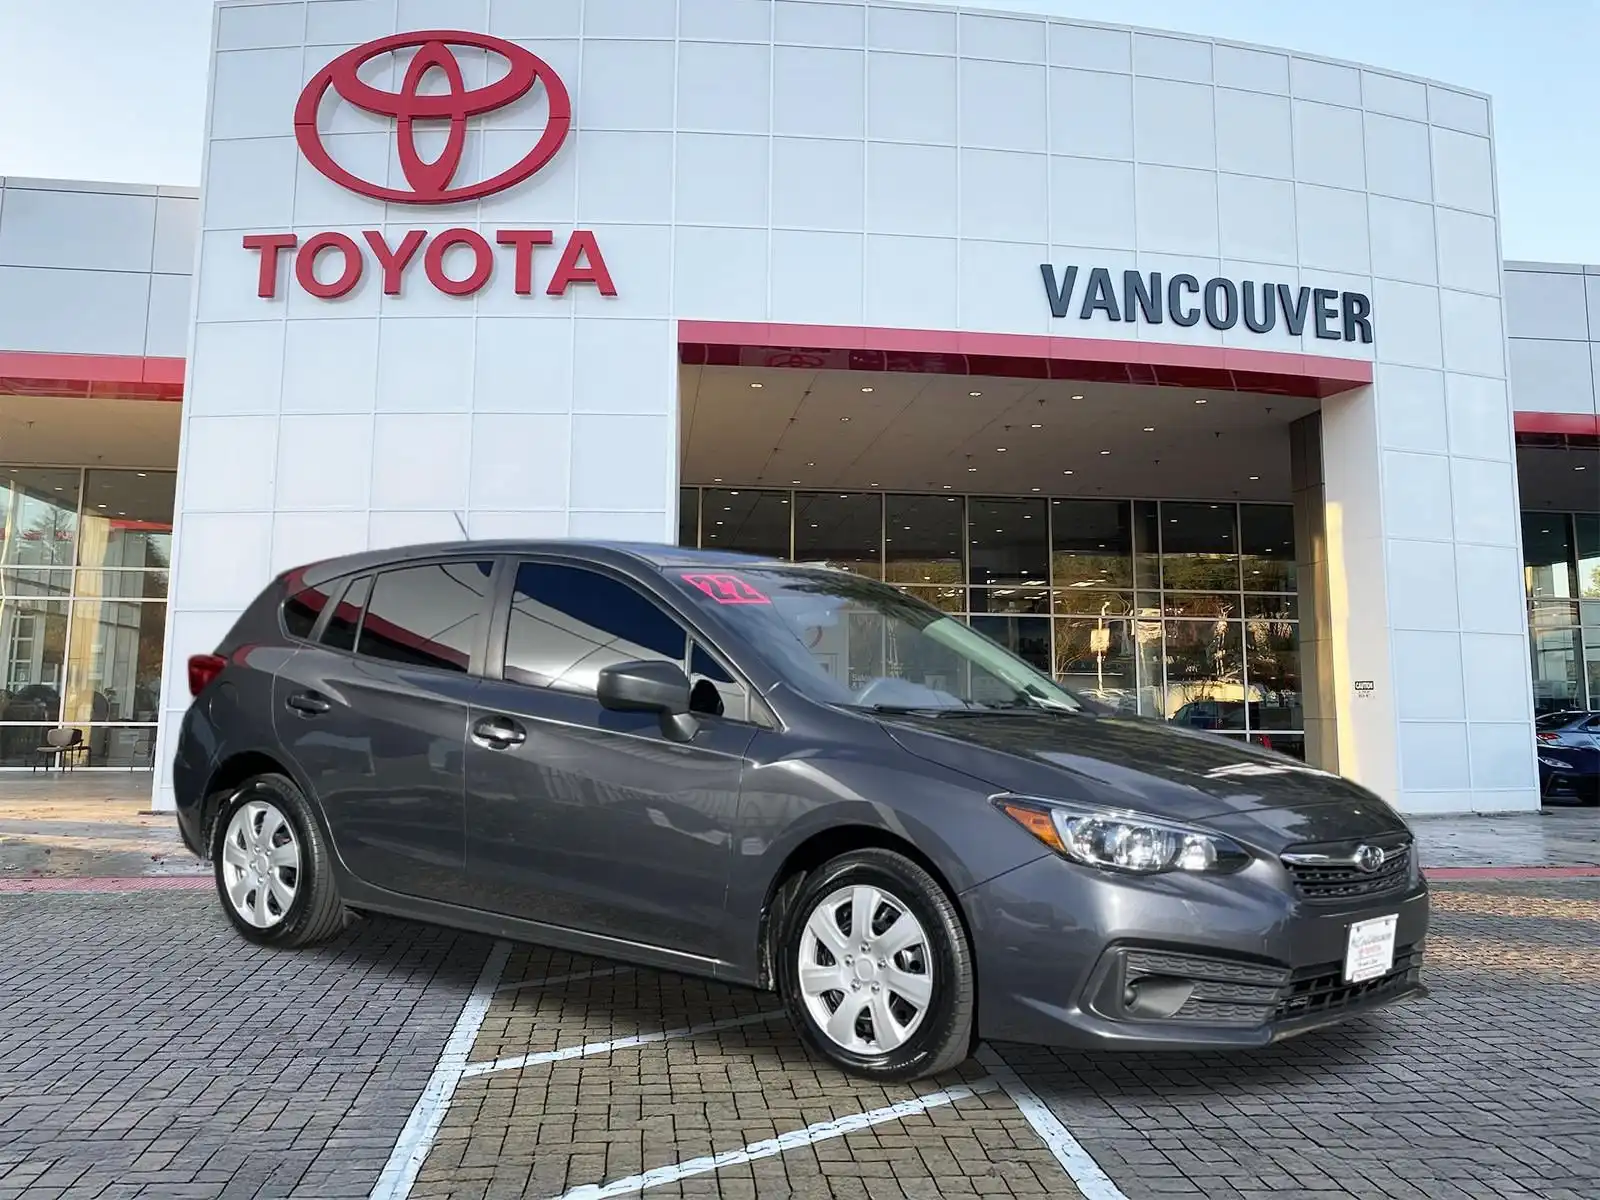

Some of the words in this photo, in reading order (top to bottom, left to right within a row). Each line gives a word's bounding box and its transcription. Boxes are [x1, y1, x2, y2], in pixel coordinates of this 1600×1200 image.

[243, 228, 618, 299] TOYOTA
[1040, 264, 1373, 343] VANCOUVER
[682, 574, 771, 604] 22
